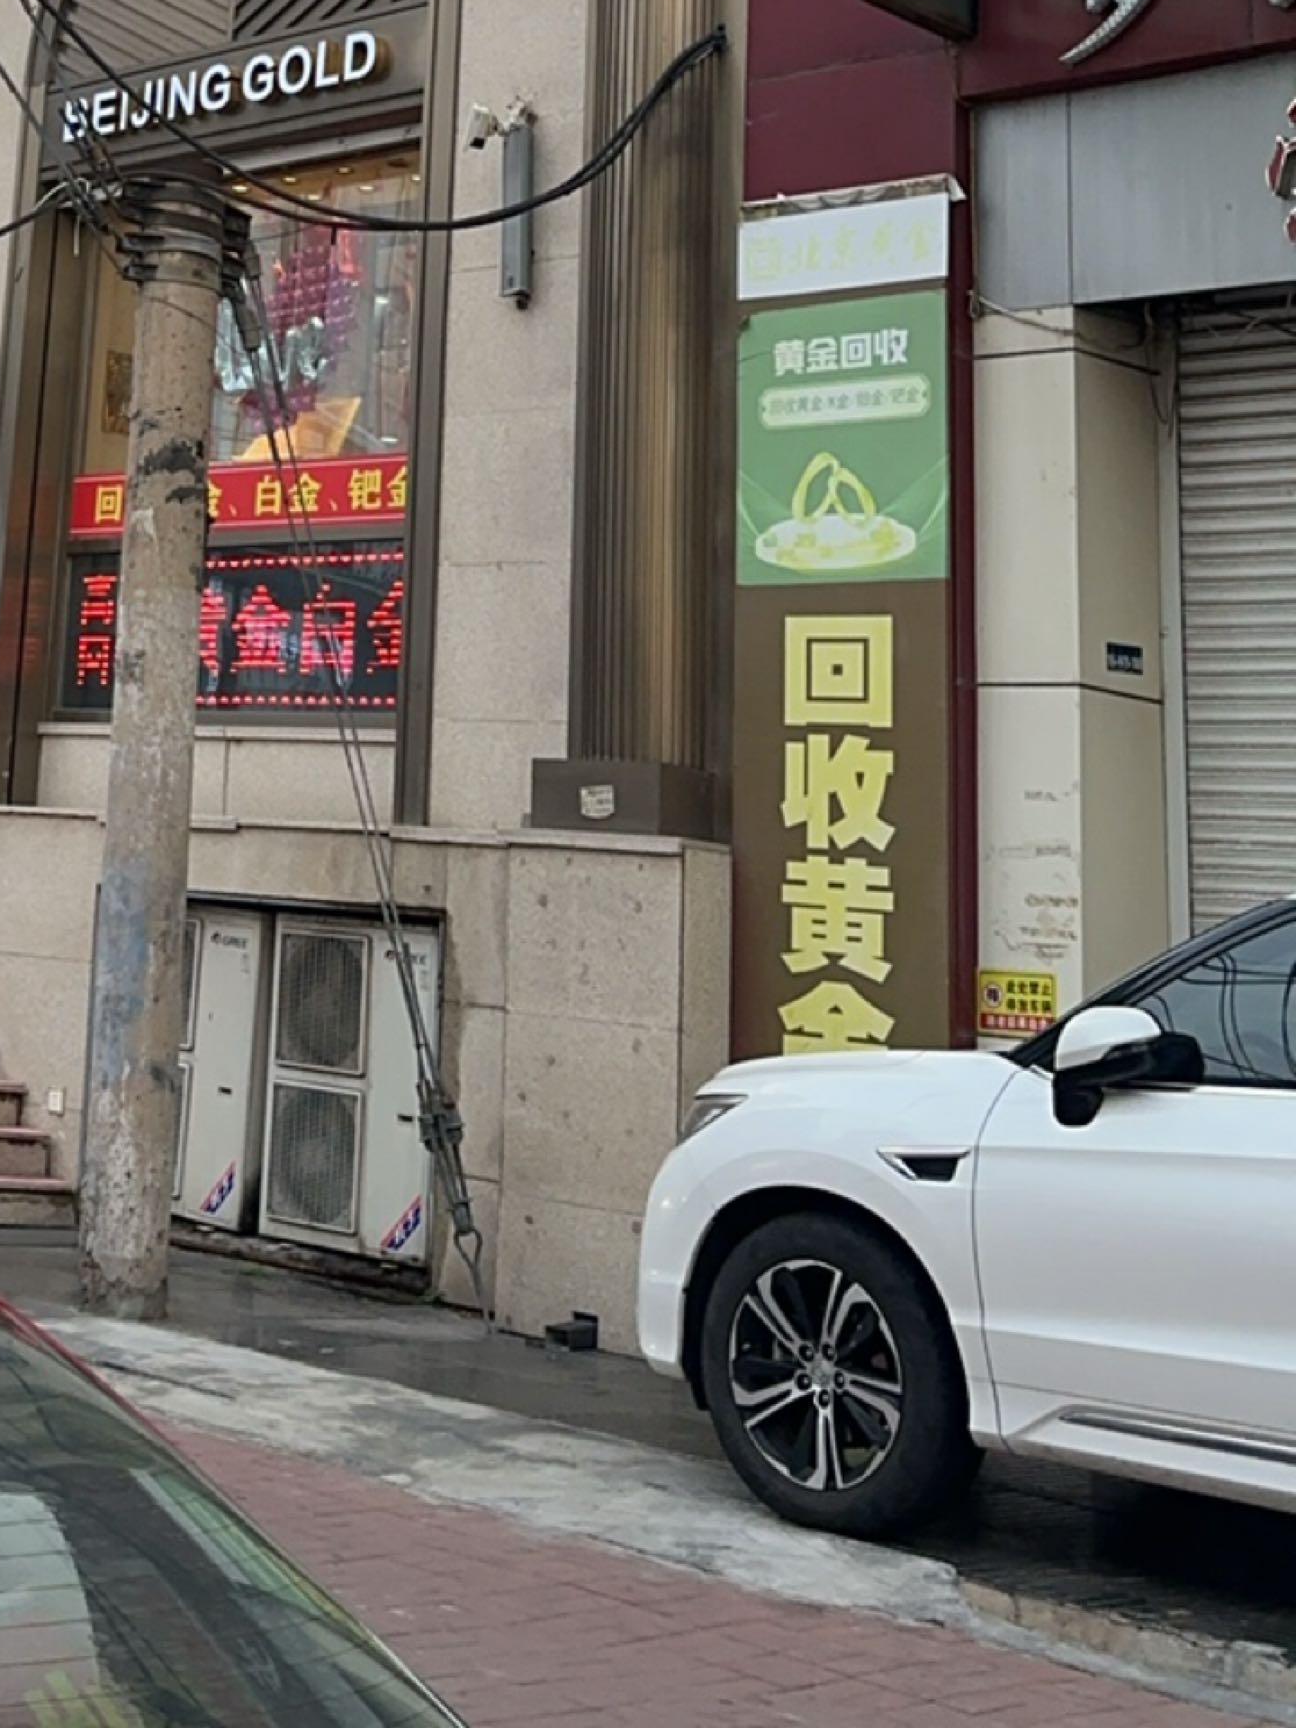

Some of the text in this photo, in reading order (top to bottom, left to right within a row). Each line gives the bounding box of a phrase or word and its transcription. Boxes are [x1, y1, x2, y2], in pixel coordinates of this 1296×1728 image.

[62, 29, 377, 144] BEIJING GOLD
[773, 328, 909, 377] 黄金回收
[778, 614, 896, 1056] 回收黄金
